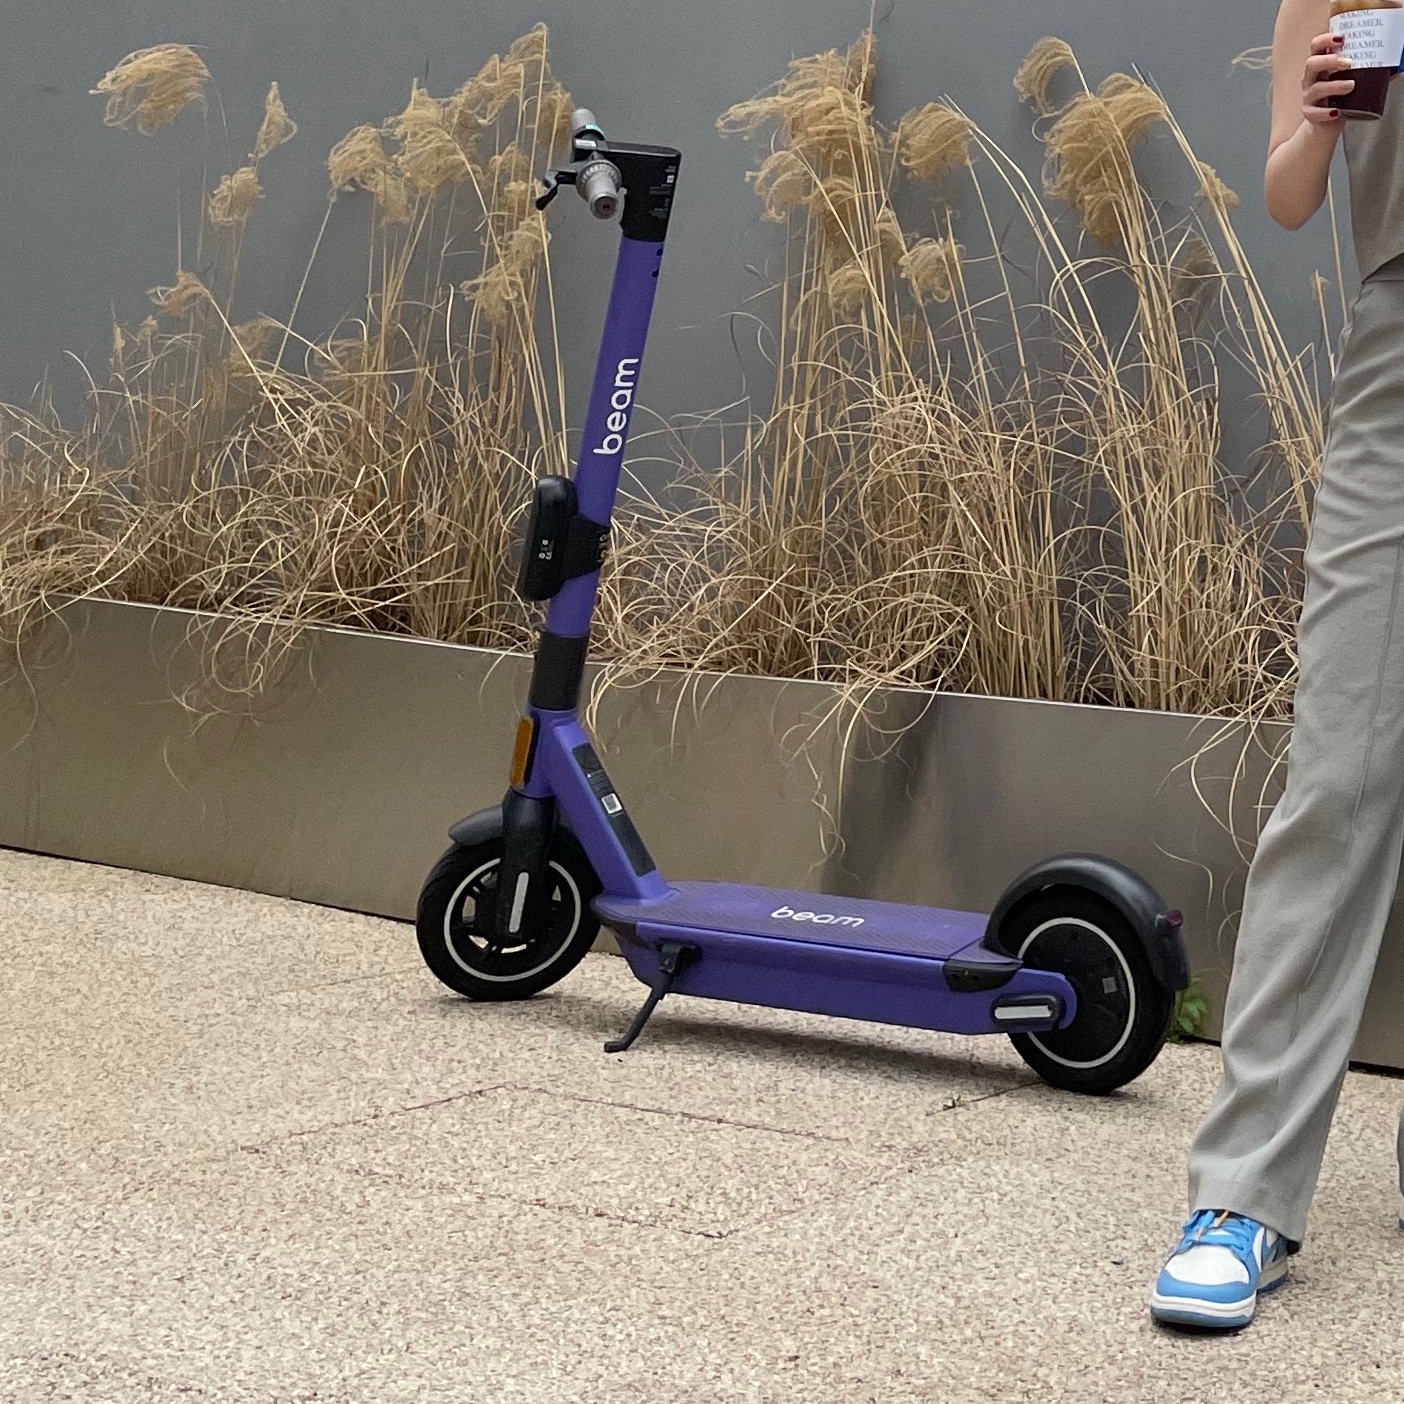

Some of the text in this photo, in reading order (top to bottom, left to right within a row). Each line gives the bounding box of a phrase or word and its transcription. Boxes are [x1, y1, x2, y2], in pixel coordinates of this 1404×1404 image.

[1339, 18, 1384, 30] DREAMER
[1346, 51, 1377, 61] AKING
[593, 358, 639, 455] beam
[770, 905, 865, 928] beam
